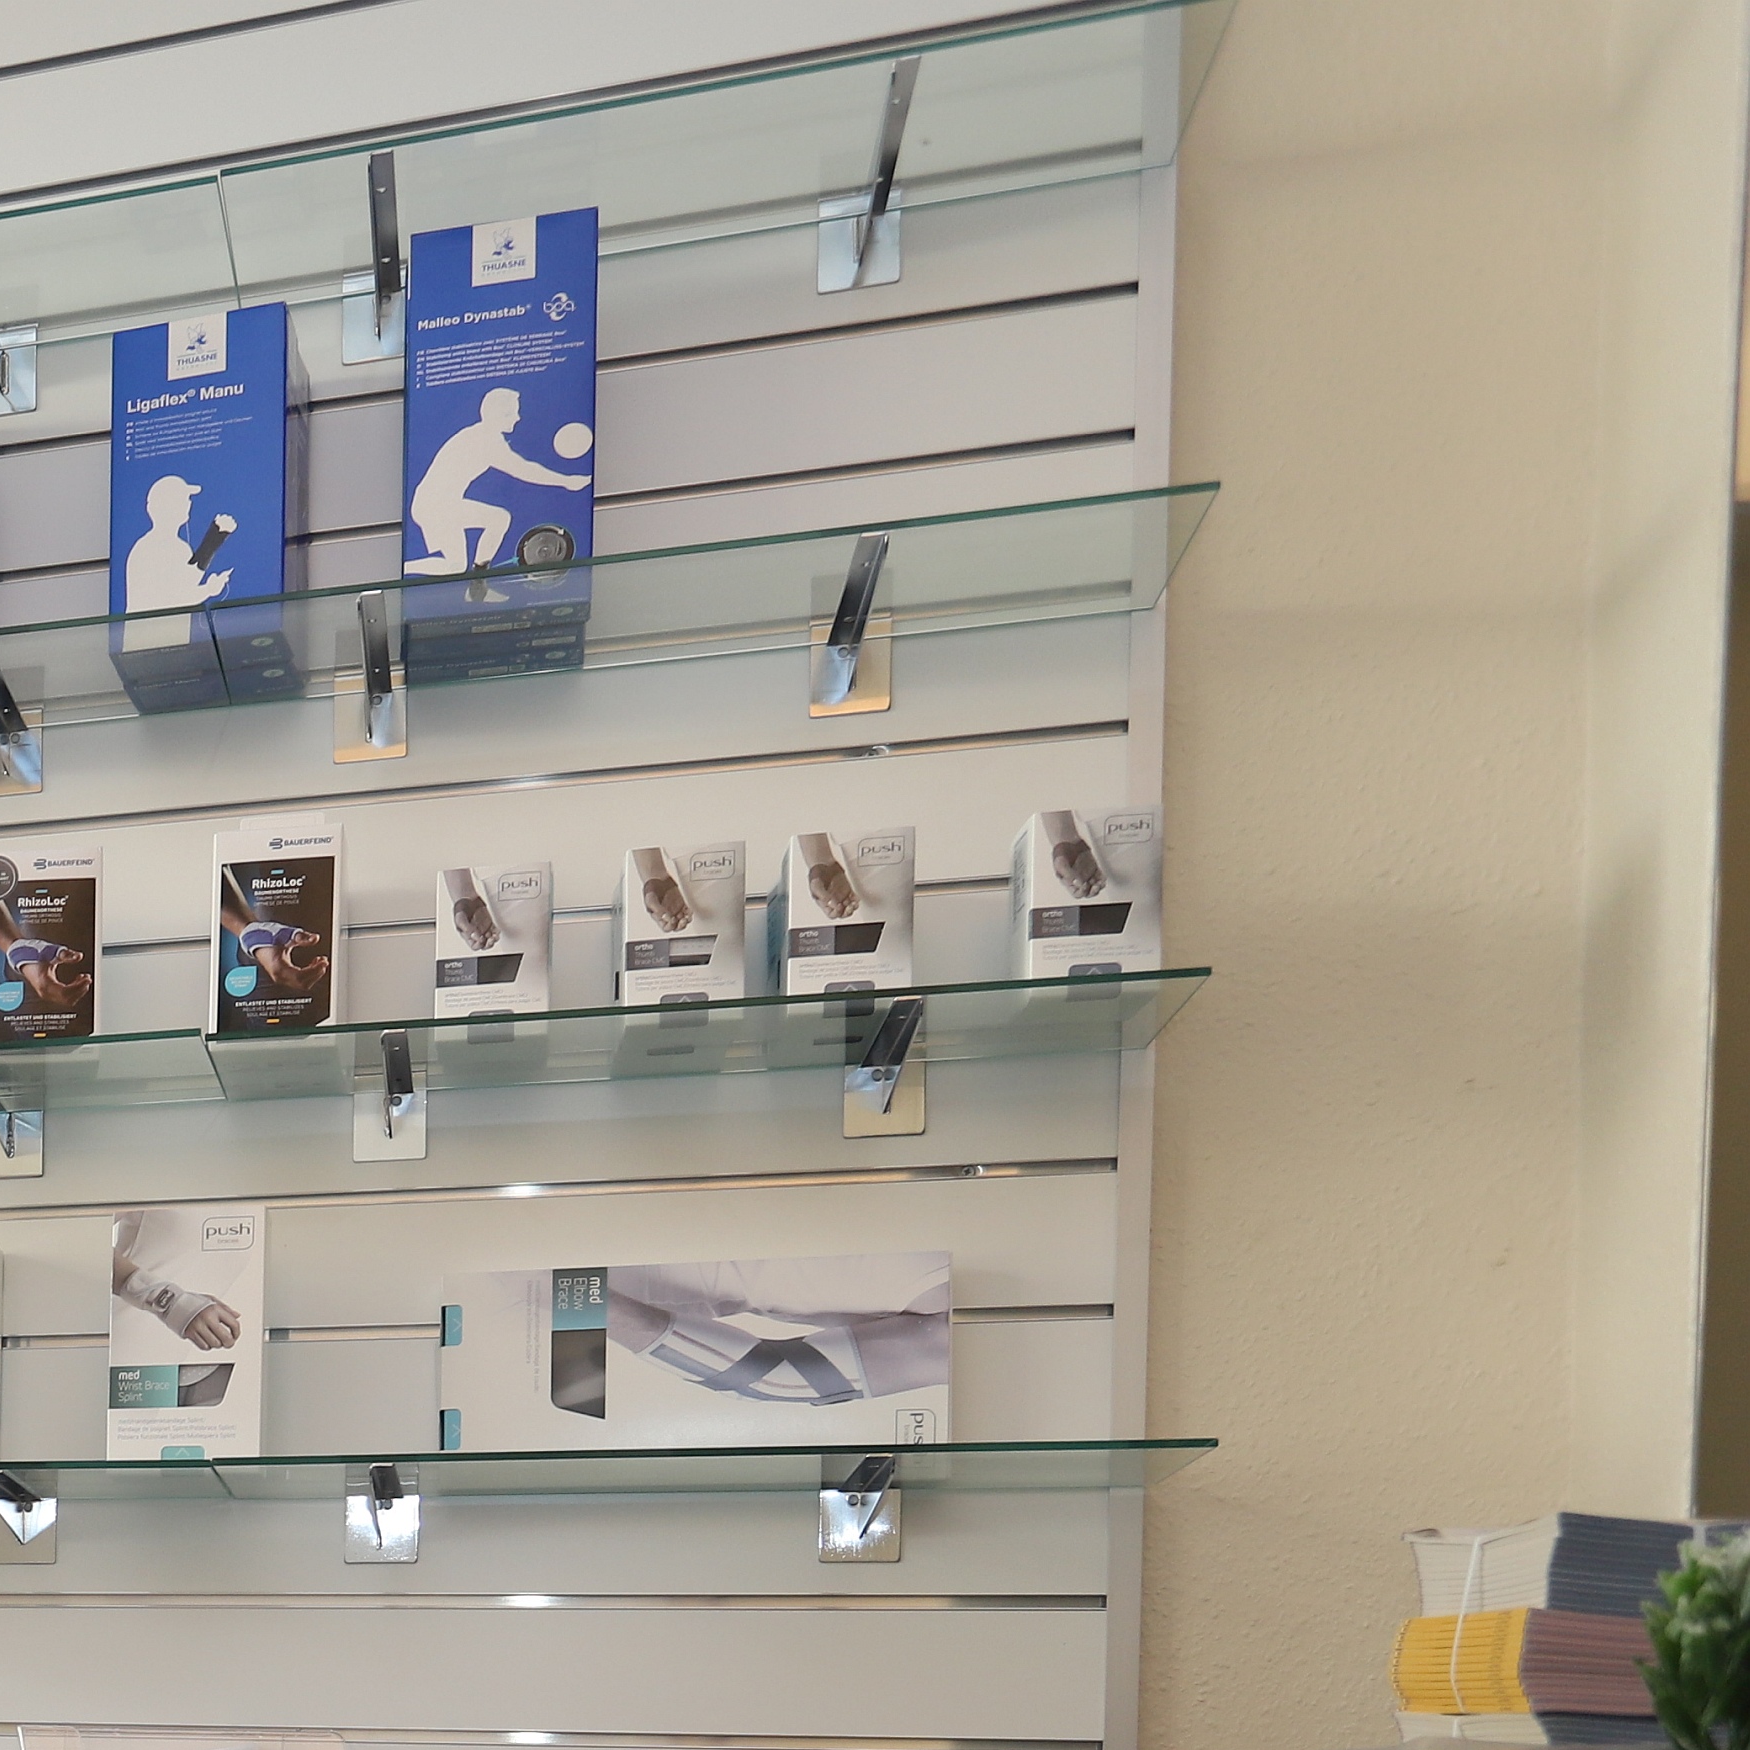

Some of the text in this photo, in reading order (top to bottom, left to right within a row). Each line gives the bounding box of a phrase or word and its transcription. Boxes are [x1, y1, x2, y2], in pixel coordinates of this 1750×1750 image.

[482, 258, 527, 273] THUASNE
[417, 314, 460, 332] Malleo
[176, 352, 218, 366] THUASNE
[199, 381, 244, 400] Manu
[1107, 818, 1151, 834] push
[284, 836, 333, 848] BAUERFEIND
[860, 841, 901, 856] push
[48, 858, 94, 868] BAUERFEIND
[693, 855, 734, 871] push
[251, 875, 304, 890] RhizoLoc
[500, 876, 539, 892] push
[17, 894, 67, 908] RhizoLoc
[206, 1222, 251, 1240] push
[557, 1276, 572, 1310] Brace
[573, 1276, 587, 1311] Elbow
[588, 1276, 602, 1304] med
[118, 1370, 140, 1381] med
[118, 1380, 170, 1391] Wrist Brace
[118, 1391, 143, 1402] Splint
[910, 1412, 925, 1445] pus
